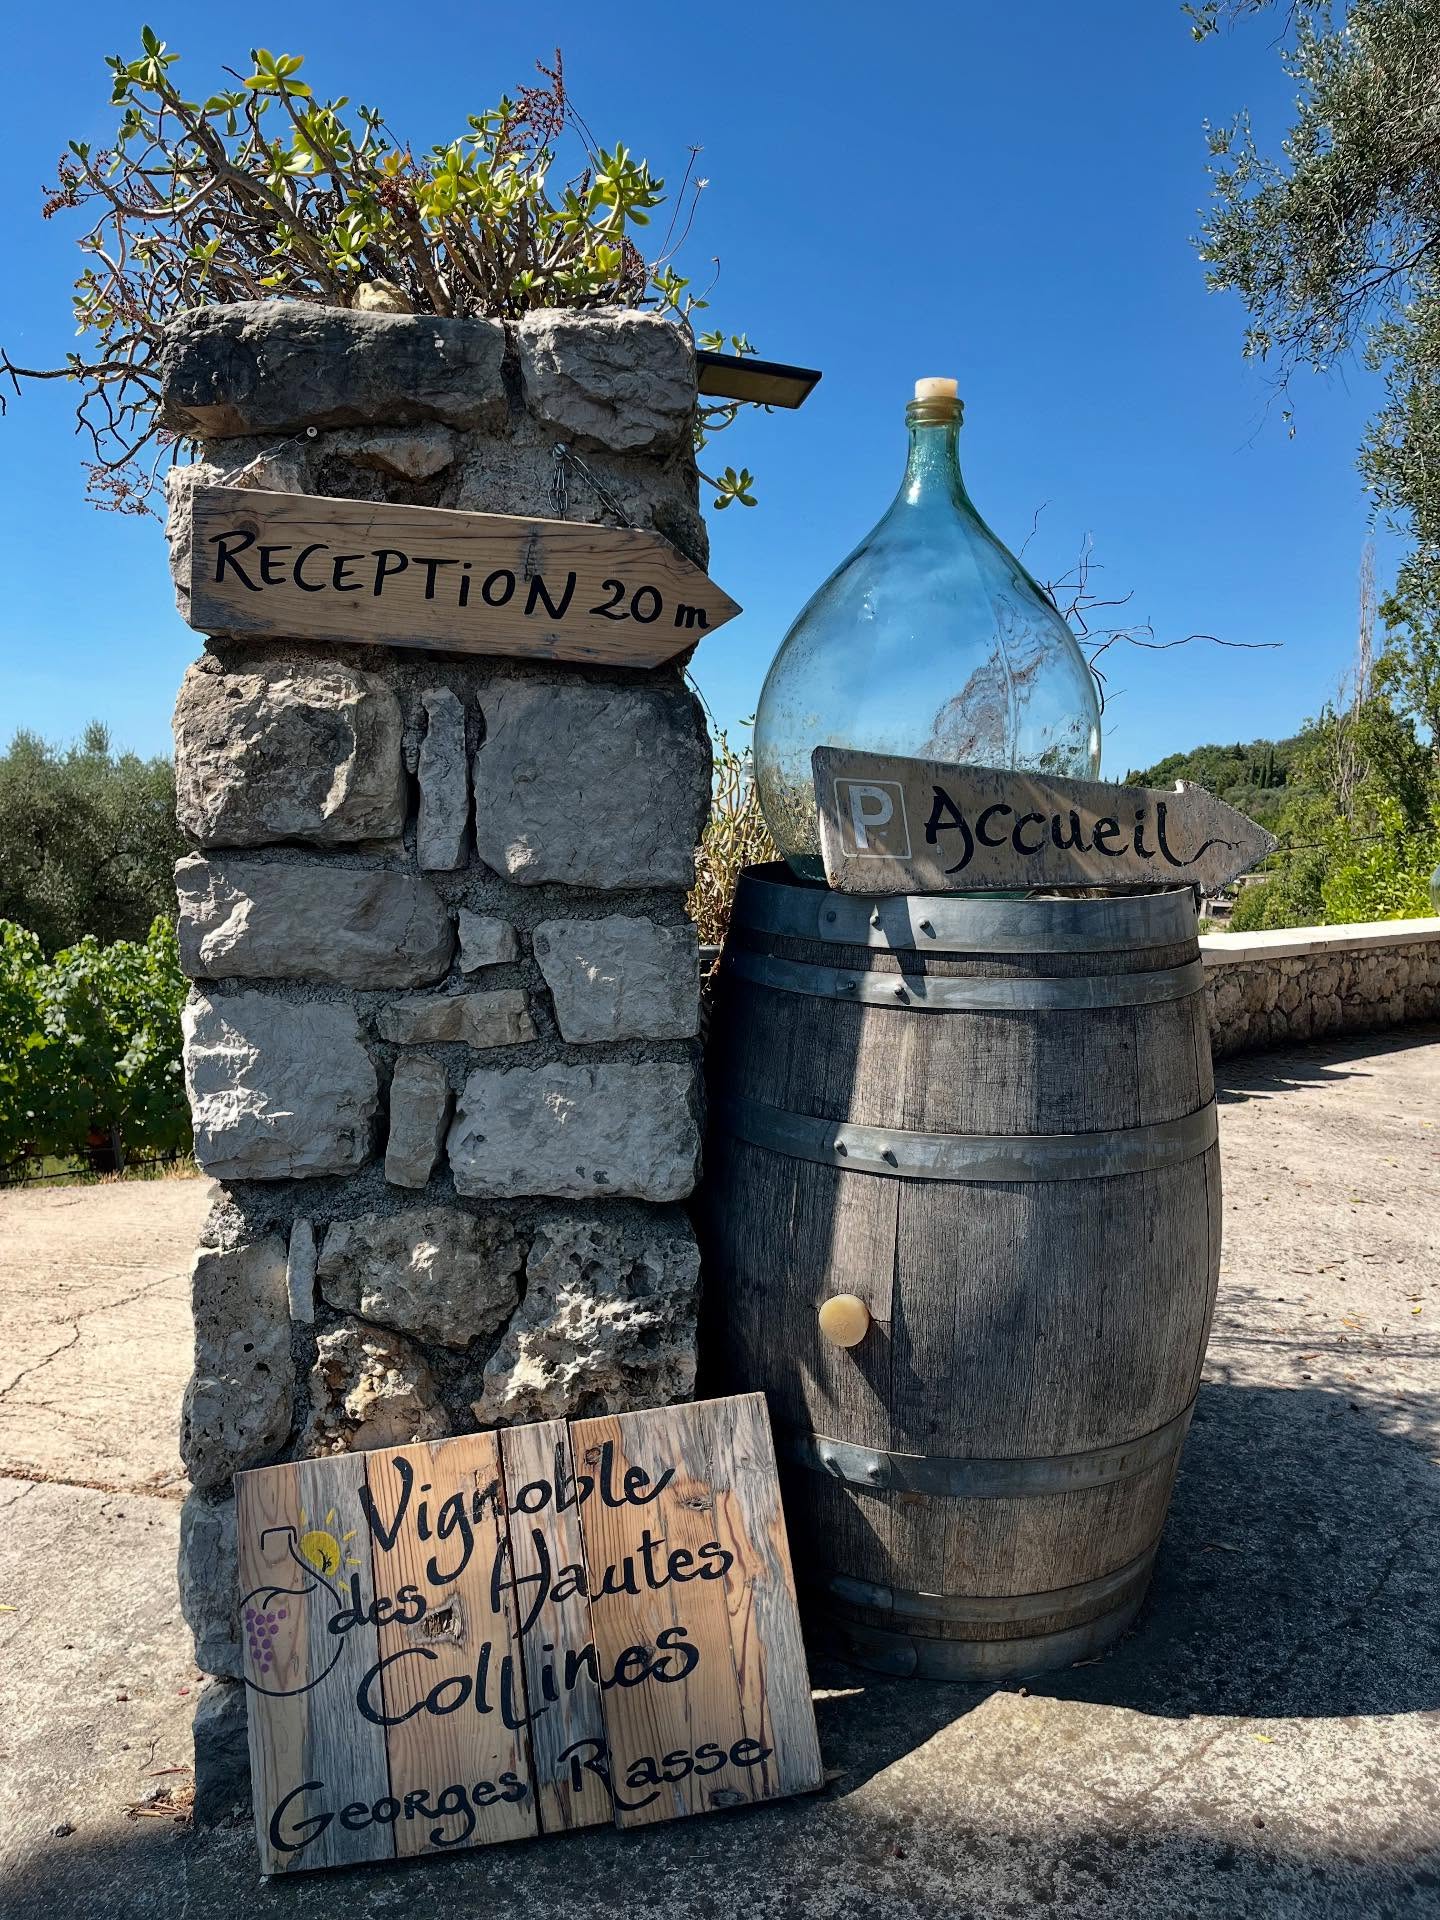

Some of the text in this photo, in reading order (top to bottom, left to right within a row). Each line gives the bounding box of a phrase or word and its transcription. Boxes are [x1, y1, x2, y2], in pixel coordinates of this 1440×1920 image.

[589, 578, 663, 624] 20
[674, 602, 711, 630] m
[848, 784, 1246, 875] P Accueil
[357, 1440, 676, 1584] Vignoble
[328, 1528, 734, 1639] des Hautes
[356, 1624, 701, 1730] Collines
[557, 1733, 774, 1812] Rasse
